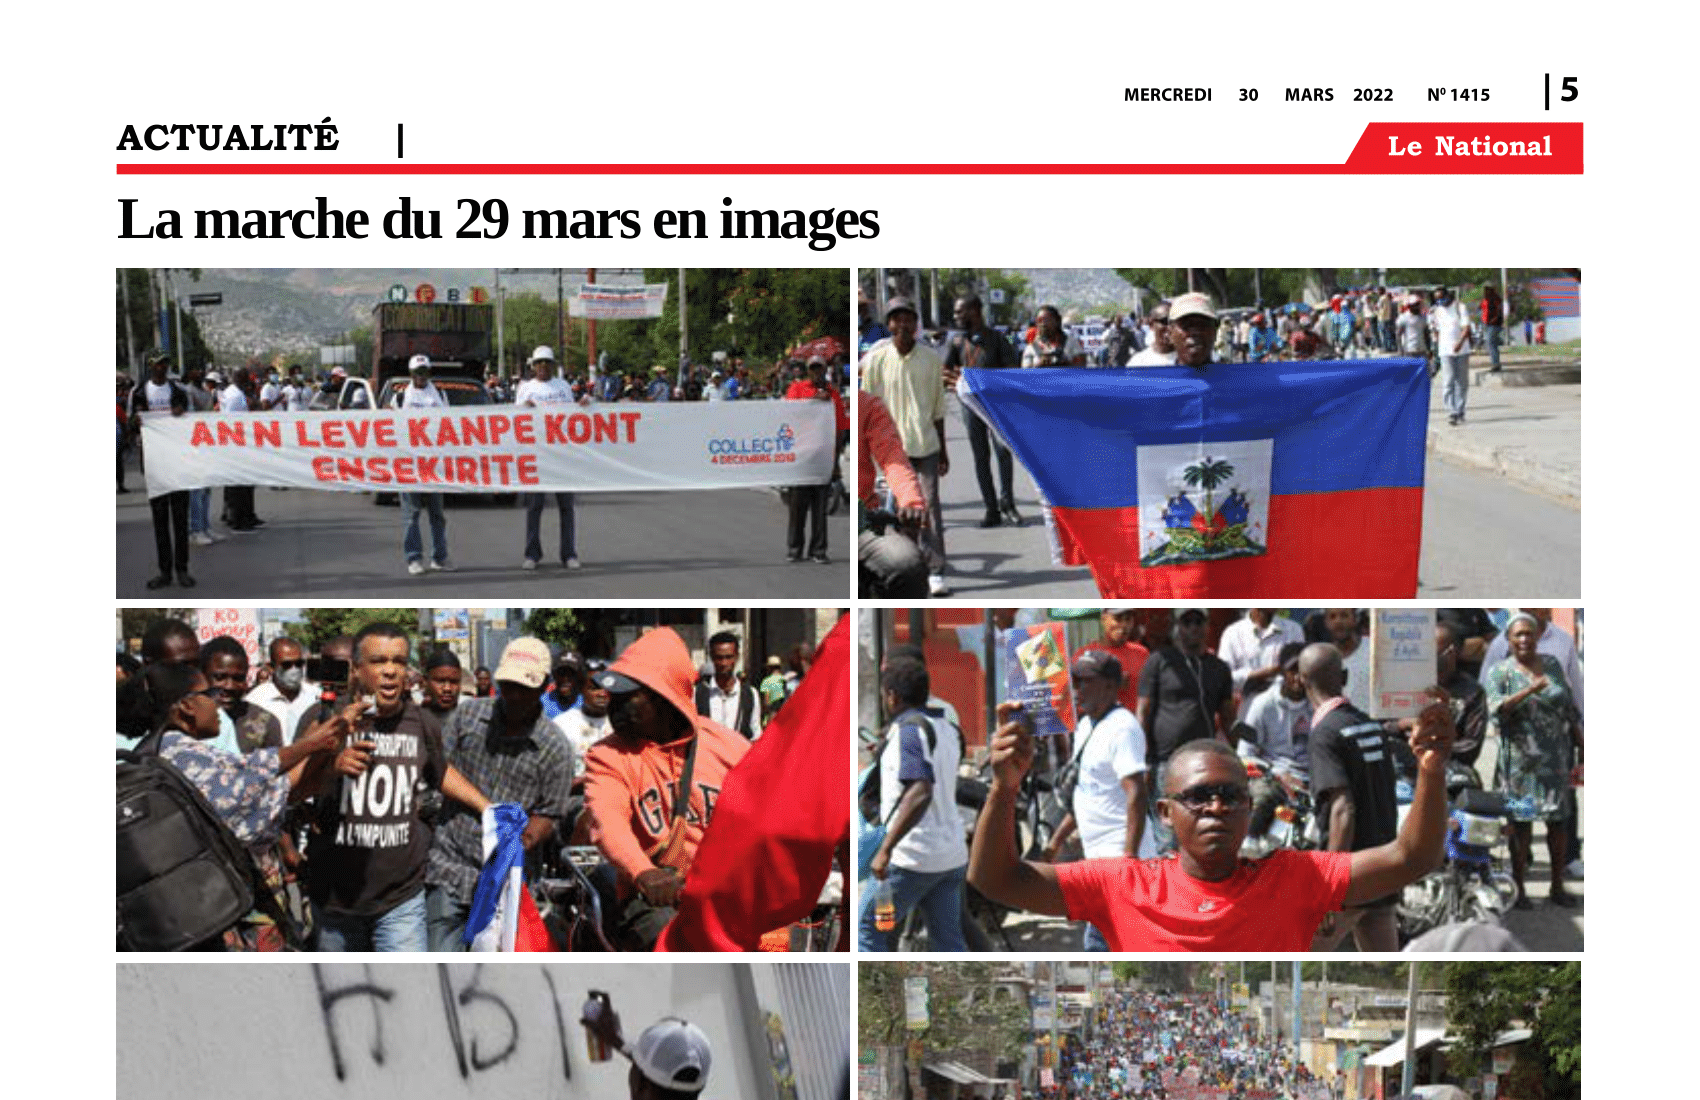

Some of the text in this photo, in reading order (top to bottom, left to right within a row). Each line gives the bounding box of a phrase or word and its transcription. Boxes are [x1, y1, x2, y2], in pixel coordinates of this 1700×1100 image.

[1125, 88, 1211, 102] MERCREDI
[1239, 88, 1258, 102] 30
[1286, 88, 1333, 102] MARS
[1354, 88, 1393, 102] 2022
[1451, 88, 1489, 102] 1415
[1561, 77, 1578, 102] 5
[116, 116, 339, 151] ACTUALITÉ
[1389, 134, 1553, 157] Le National
[117, 197, 880, 252] La marche du 29 mars en images
[295, 419, 398, 448] LEVE
[407, 414, 537, 448] KANPE
[544, 412, 641, 445] KONT
[311, 455, 540, 487] ENSEKIRITE
[340, 764, 418, 817] NON
